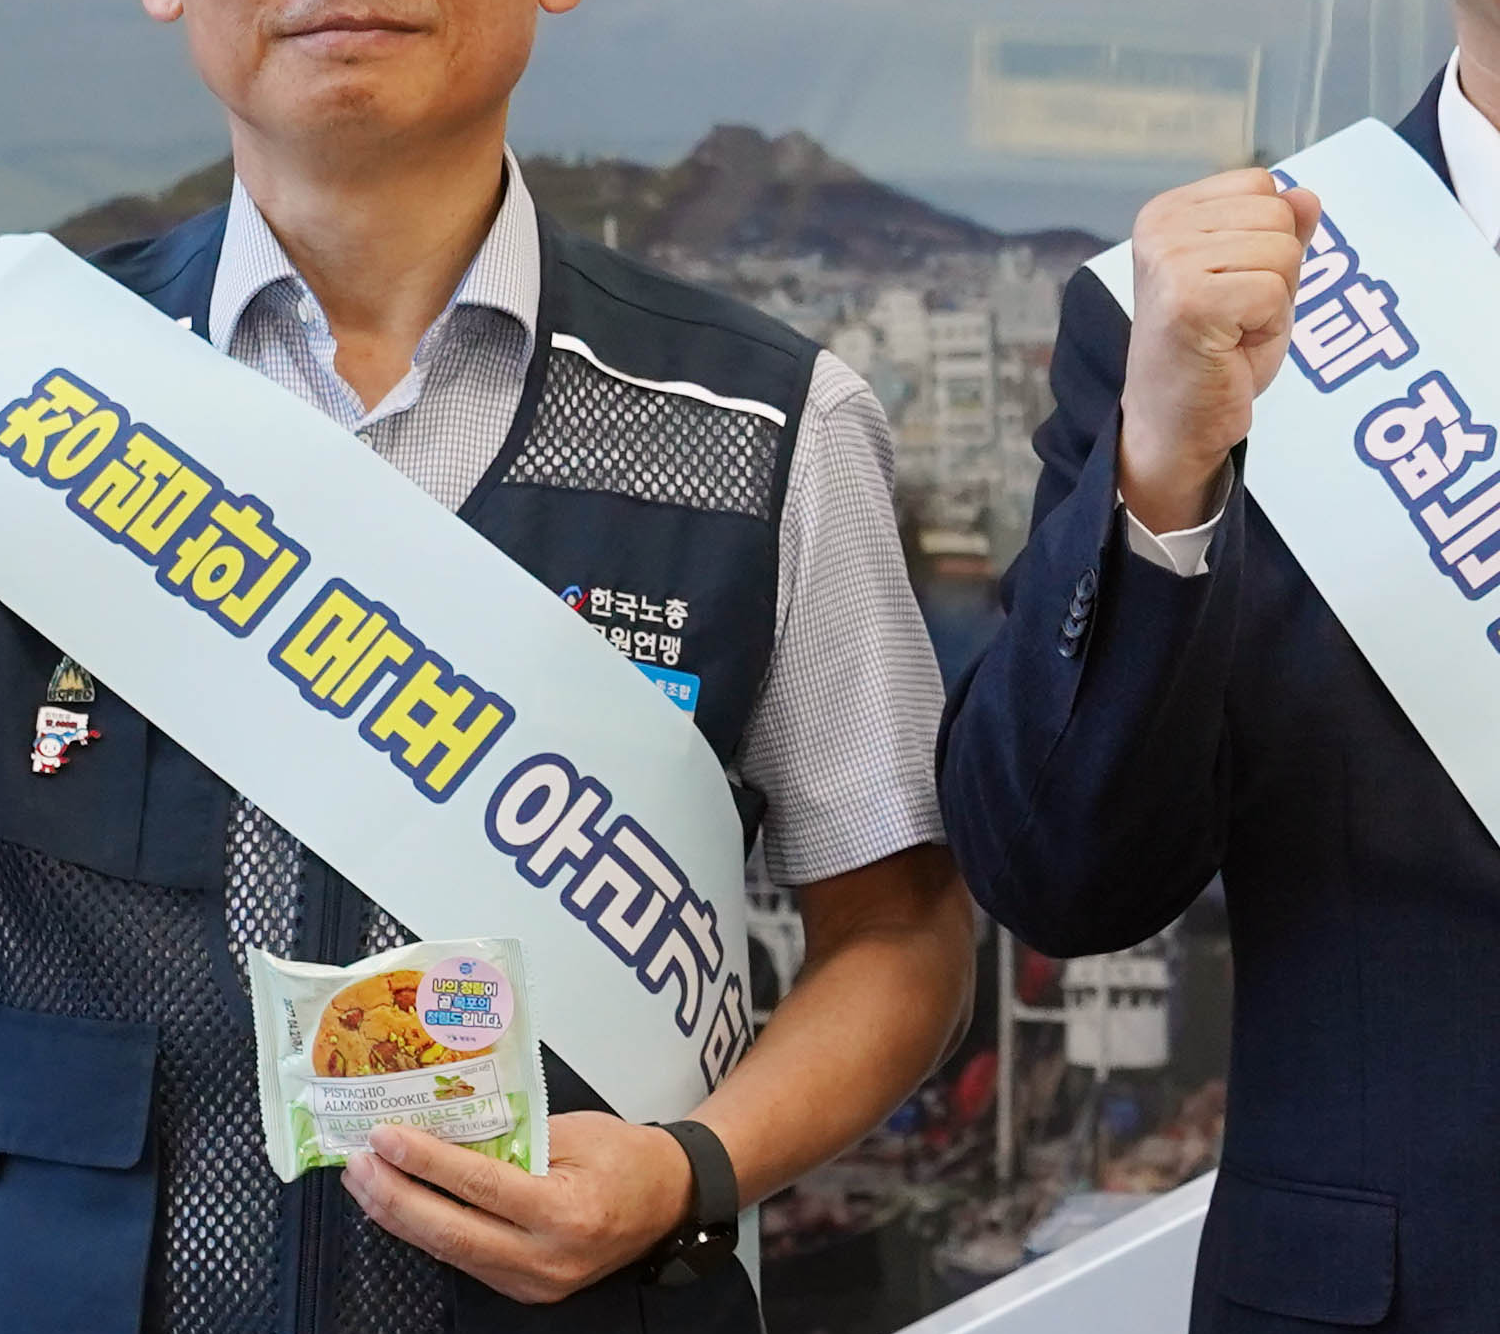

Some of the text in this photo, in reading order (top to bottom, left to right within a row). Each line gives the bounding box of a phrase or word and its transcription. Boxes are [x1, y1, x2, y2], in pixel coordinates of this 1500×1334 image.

[590, 587, 689, 630] 한국노총
[267, 577, 515, 804] 목포
[485, 753, 723, 1037] 우리가
[323, 1087, 386, 1099] PISTACHIO
[324, 1092, 430, 1112] ALMOND COOKIE
